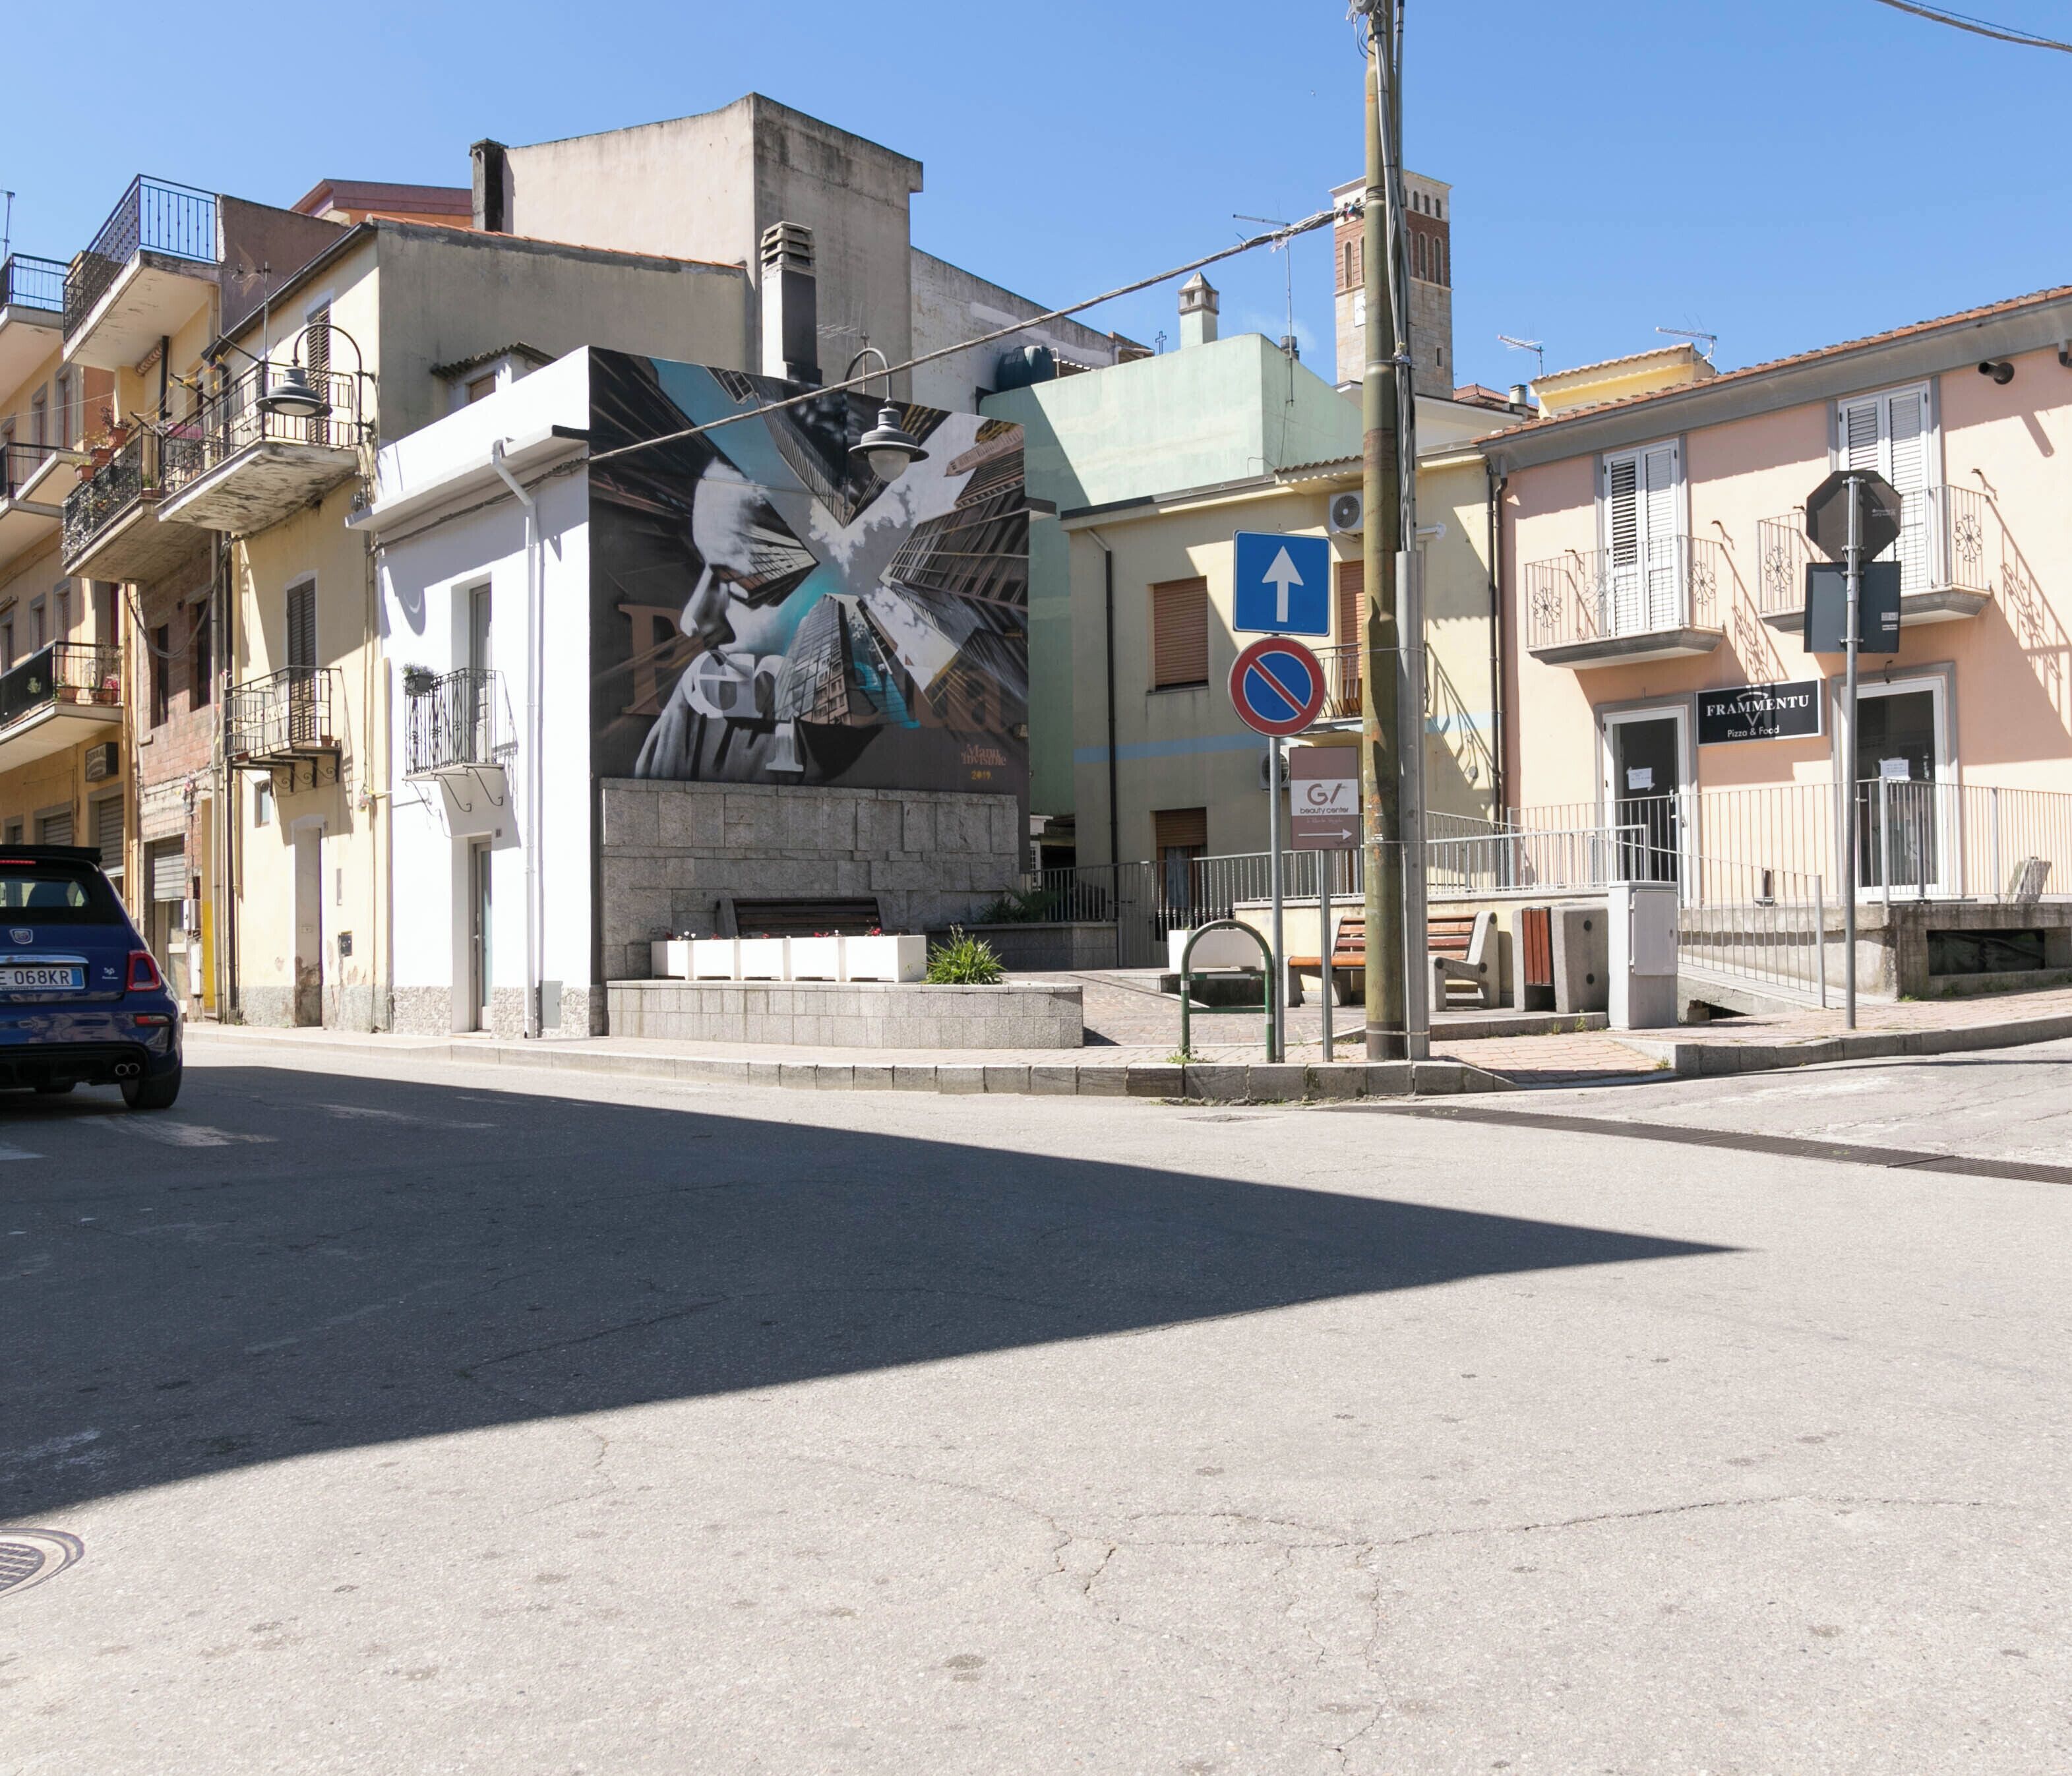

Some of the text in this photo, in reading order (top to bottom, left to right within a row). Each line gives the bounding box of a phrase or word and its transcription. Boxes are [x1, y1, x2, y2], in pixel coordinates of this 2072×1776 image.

[1706, 694, 1810, 717] FRAMMENTU
[1727, 729, 1748, 738] Pizza
[1759, 725, 1780, 735] Food
[15, 970, 70, 985] 068KR
